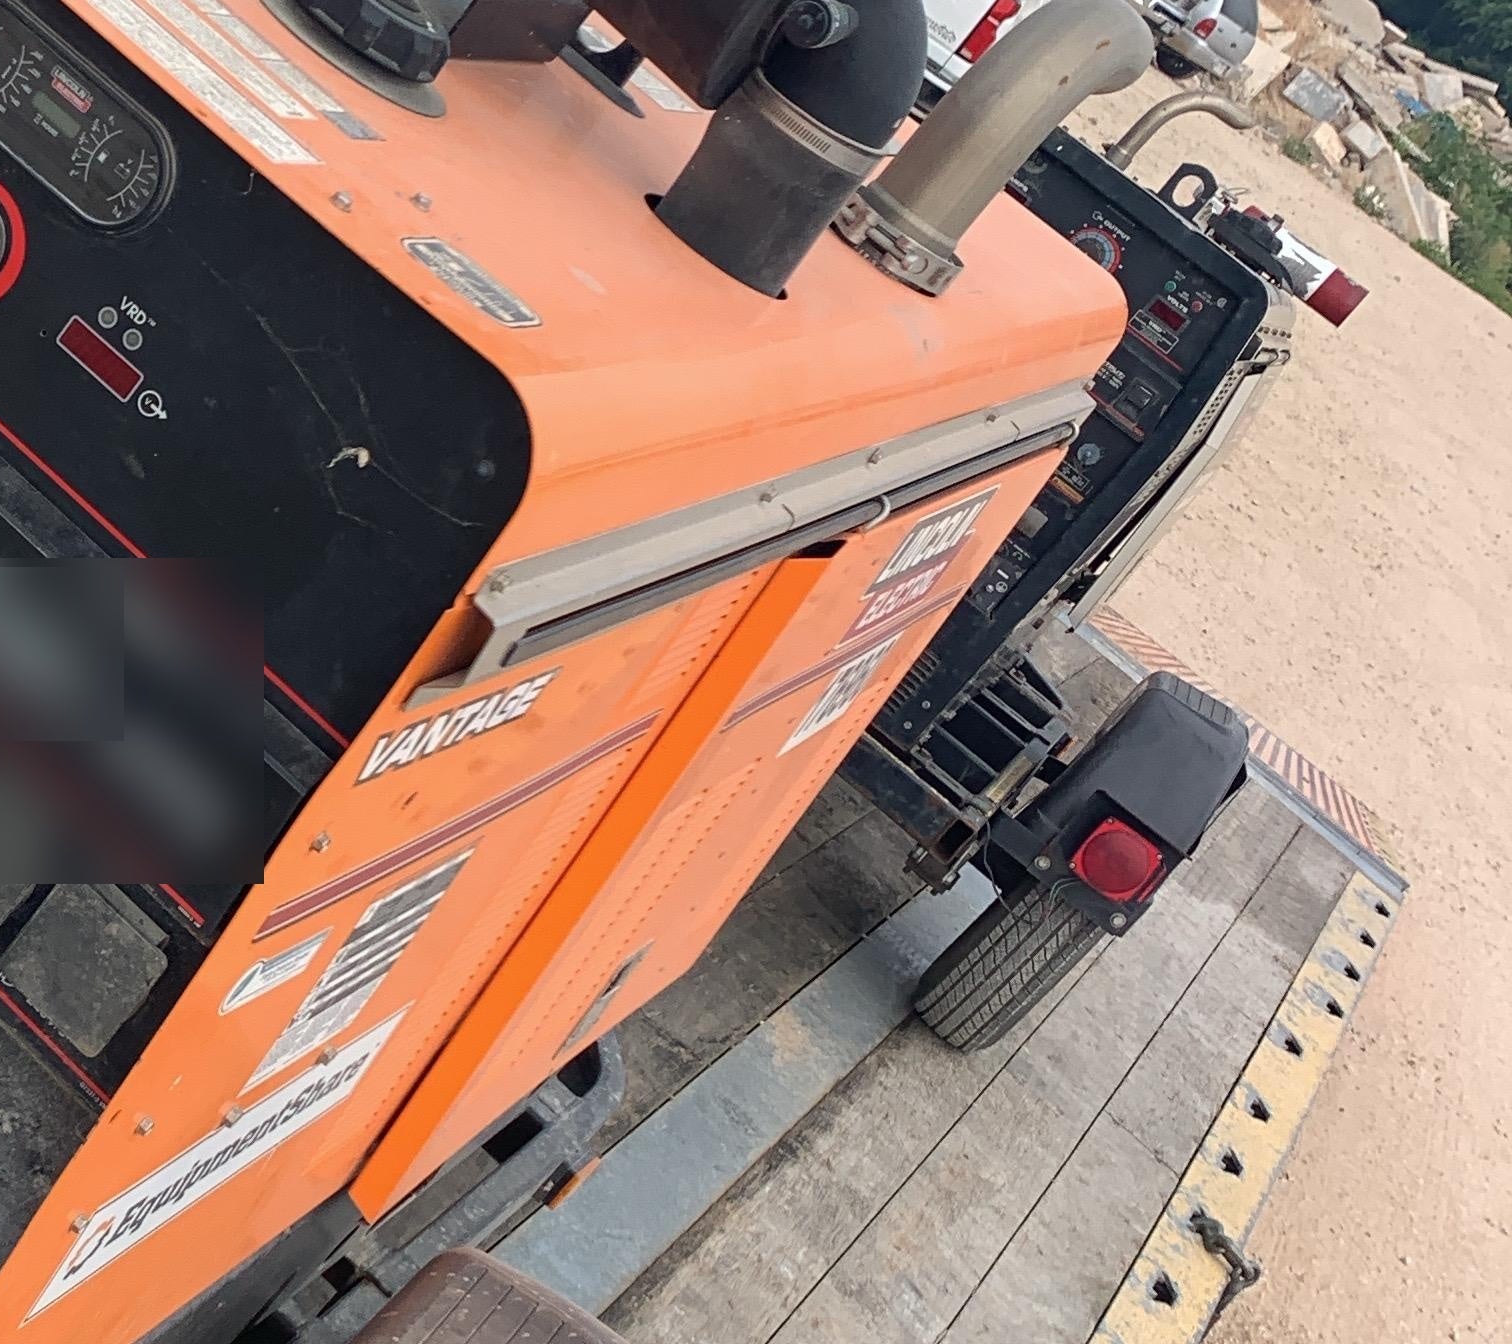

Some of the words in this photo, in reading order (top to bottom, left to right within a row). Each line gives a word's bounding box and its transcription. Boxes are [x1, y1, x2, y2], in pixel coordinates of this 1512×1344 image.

[1103, 219, 1132, 242] OUTPUT
[358, 672, 556, 779] VANTAGE
[106, 1052, 372, 1253] EquipmentShare
